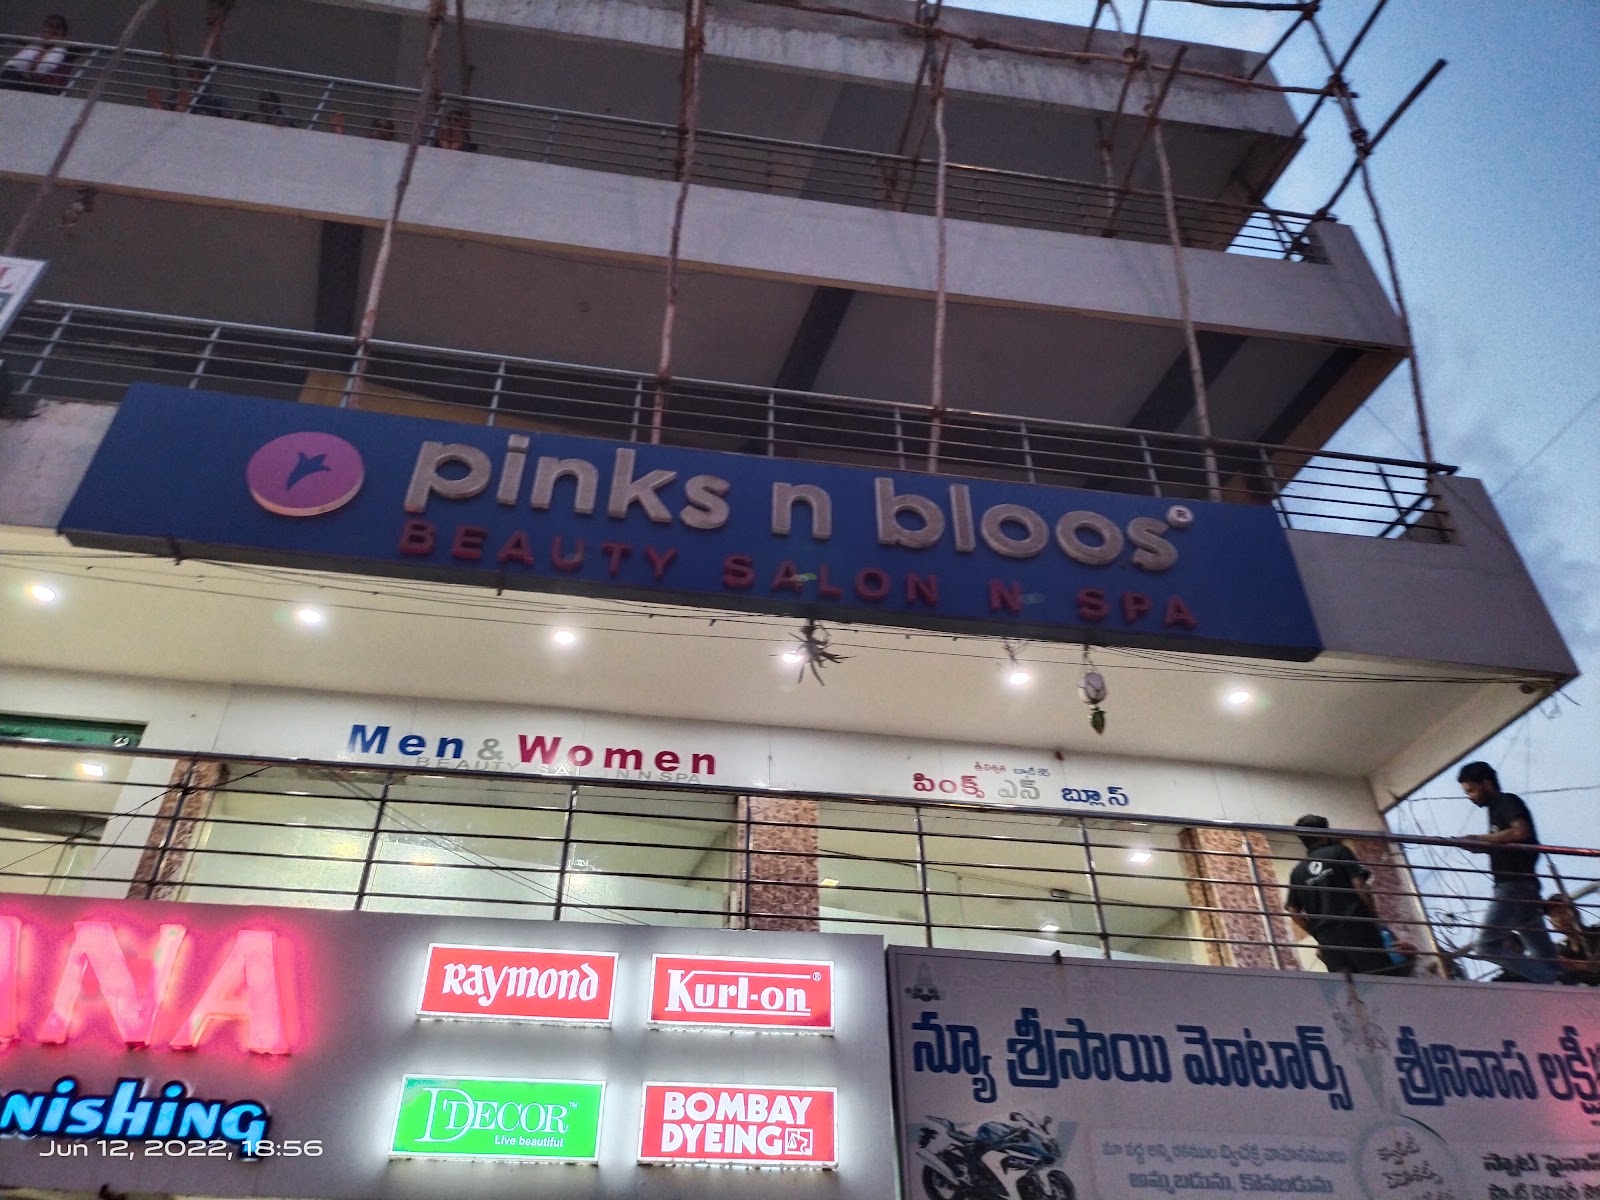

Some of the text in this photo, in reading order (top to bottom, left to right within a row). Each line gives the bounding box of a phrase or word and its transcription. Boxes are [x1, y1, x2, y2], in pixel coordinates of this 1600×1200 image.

[404, 434, 731, 530] pinks
[771, 482, 832, 540] n
[400, 518, 1199, 630] BEAUTY SALON N SPA
[347, 724, 716, 775] Men & Women
[659, 772, 700, 786] SPA
[913, 772, 985, 798] పింక్స్
[998, 779, 1041, 799] ఎన్
[441, 961, 599, 1007] Raymond
[912, 1011, 998, 1103] న్యూ
[1176, 1024, 1354, 1110] మోటార్స్
[663, 1091, 812, 1124] BOMBAY
[494, 1134, 563, 1148] Live beautiful
[661, 1123, 784, 1156] DYEING
